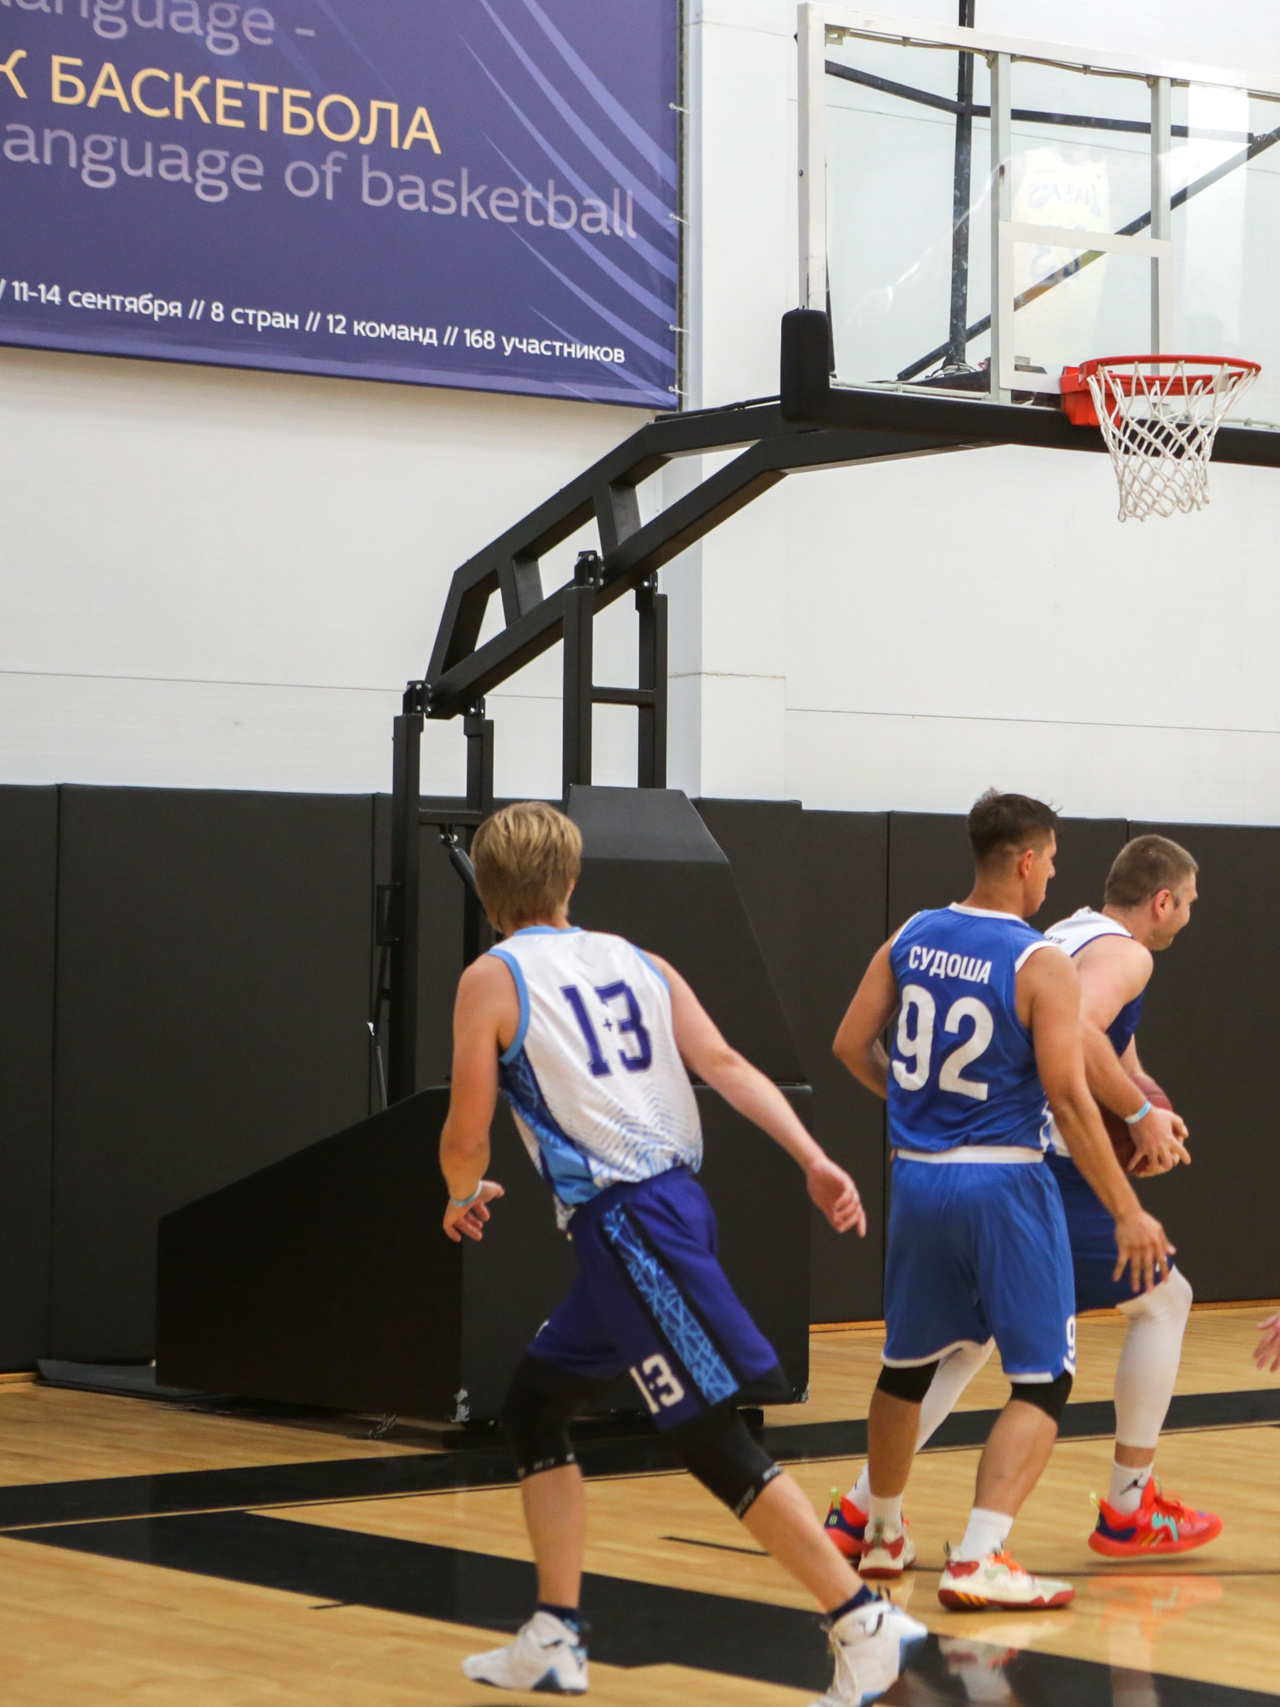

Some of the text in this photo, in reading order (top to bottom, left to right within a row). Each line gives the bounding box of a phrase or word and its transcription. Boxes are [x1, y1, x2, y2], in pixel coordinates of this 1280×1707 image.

[0, 0, 275, 56] guage
[51, 54, 442, 154] БАСКЕТБОЛА
[284, 151, 348, 201] of
[361, 154, 637, 239] basketball
[11, 280, 62, 305] 11-14
[67, 289, 183, 322] сентября
[187, 298, 206, 320] //
[210, 301, 225, 322] 8
[230, 306, 300, 332] стран
[304, 310, 322, 333] //
[326, 313, 347, 335] 12
[353, 319, 438, 347] команд
[443, 325, 459, 347] //
[463, 328, 496, 350] 168
[500, 334, 626, 364] участников
[908, 945, 993, 985] СУДОША
[559, 979, 653, 1079] 13
[891, 983, 995, 1101] 92
[629, 1353, 685, 1415] 13
